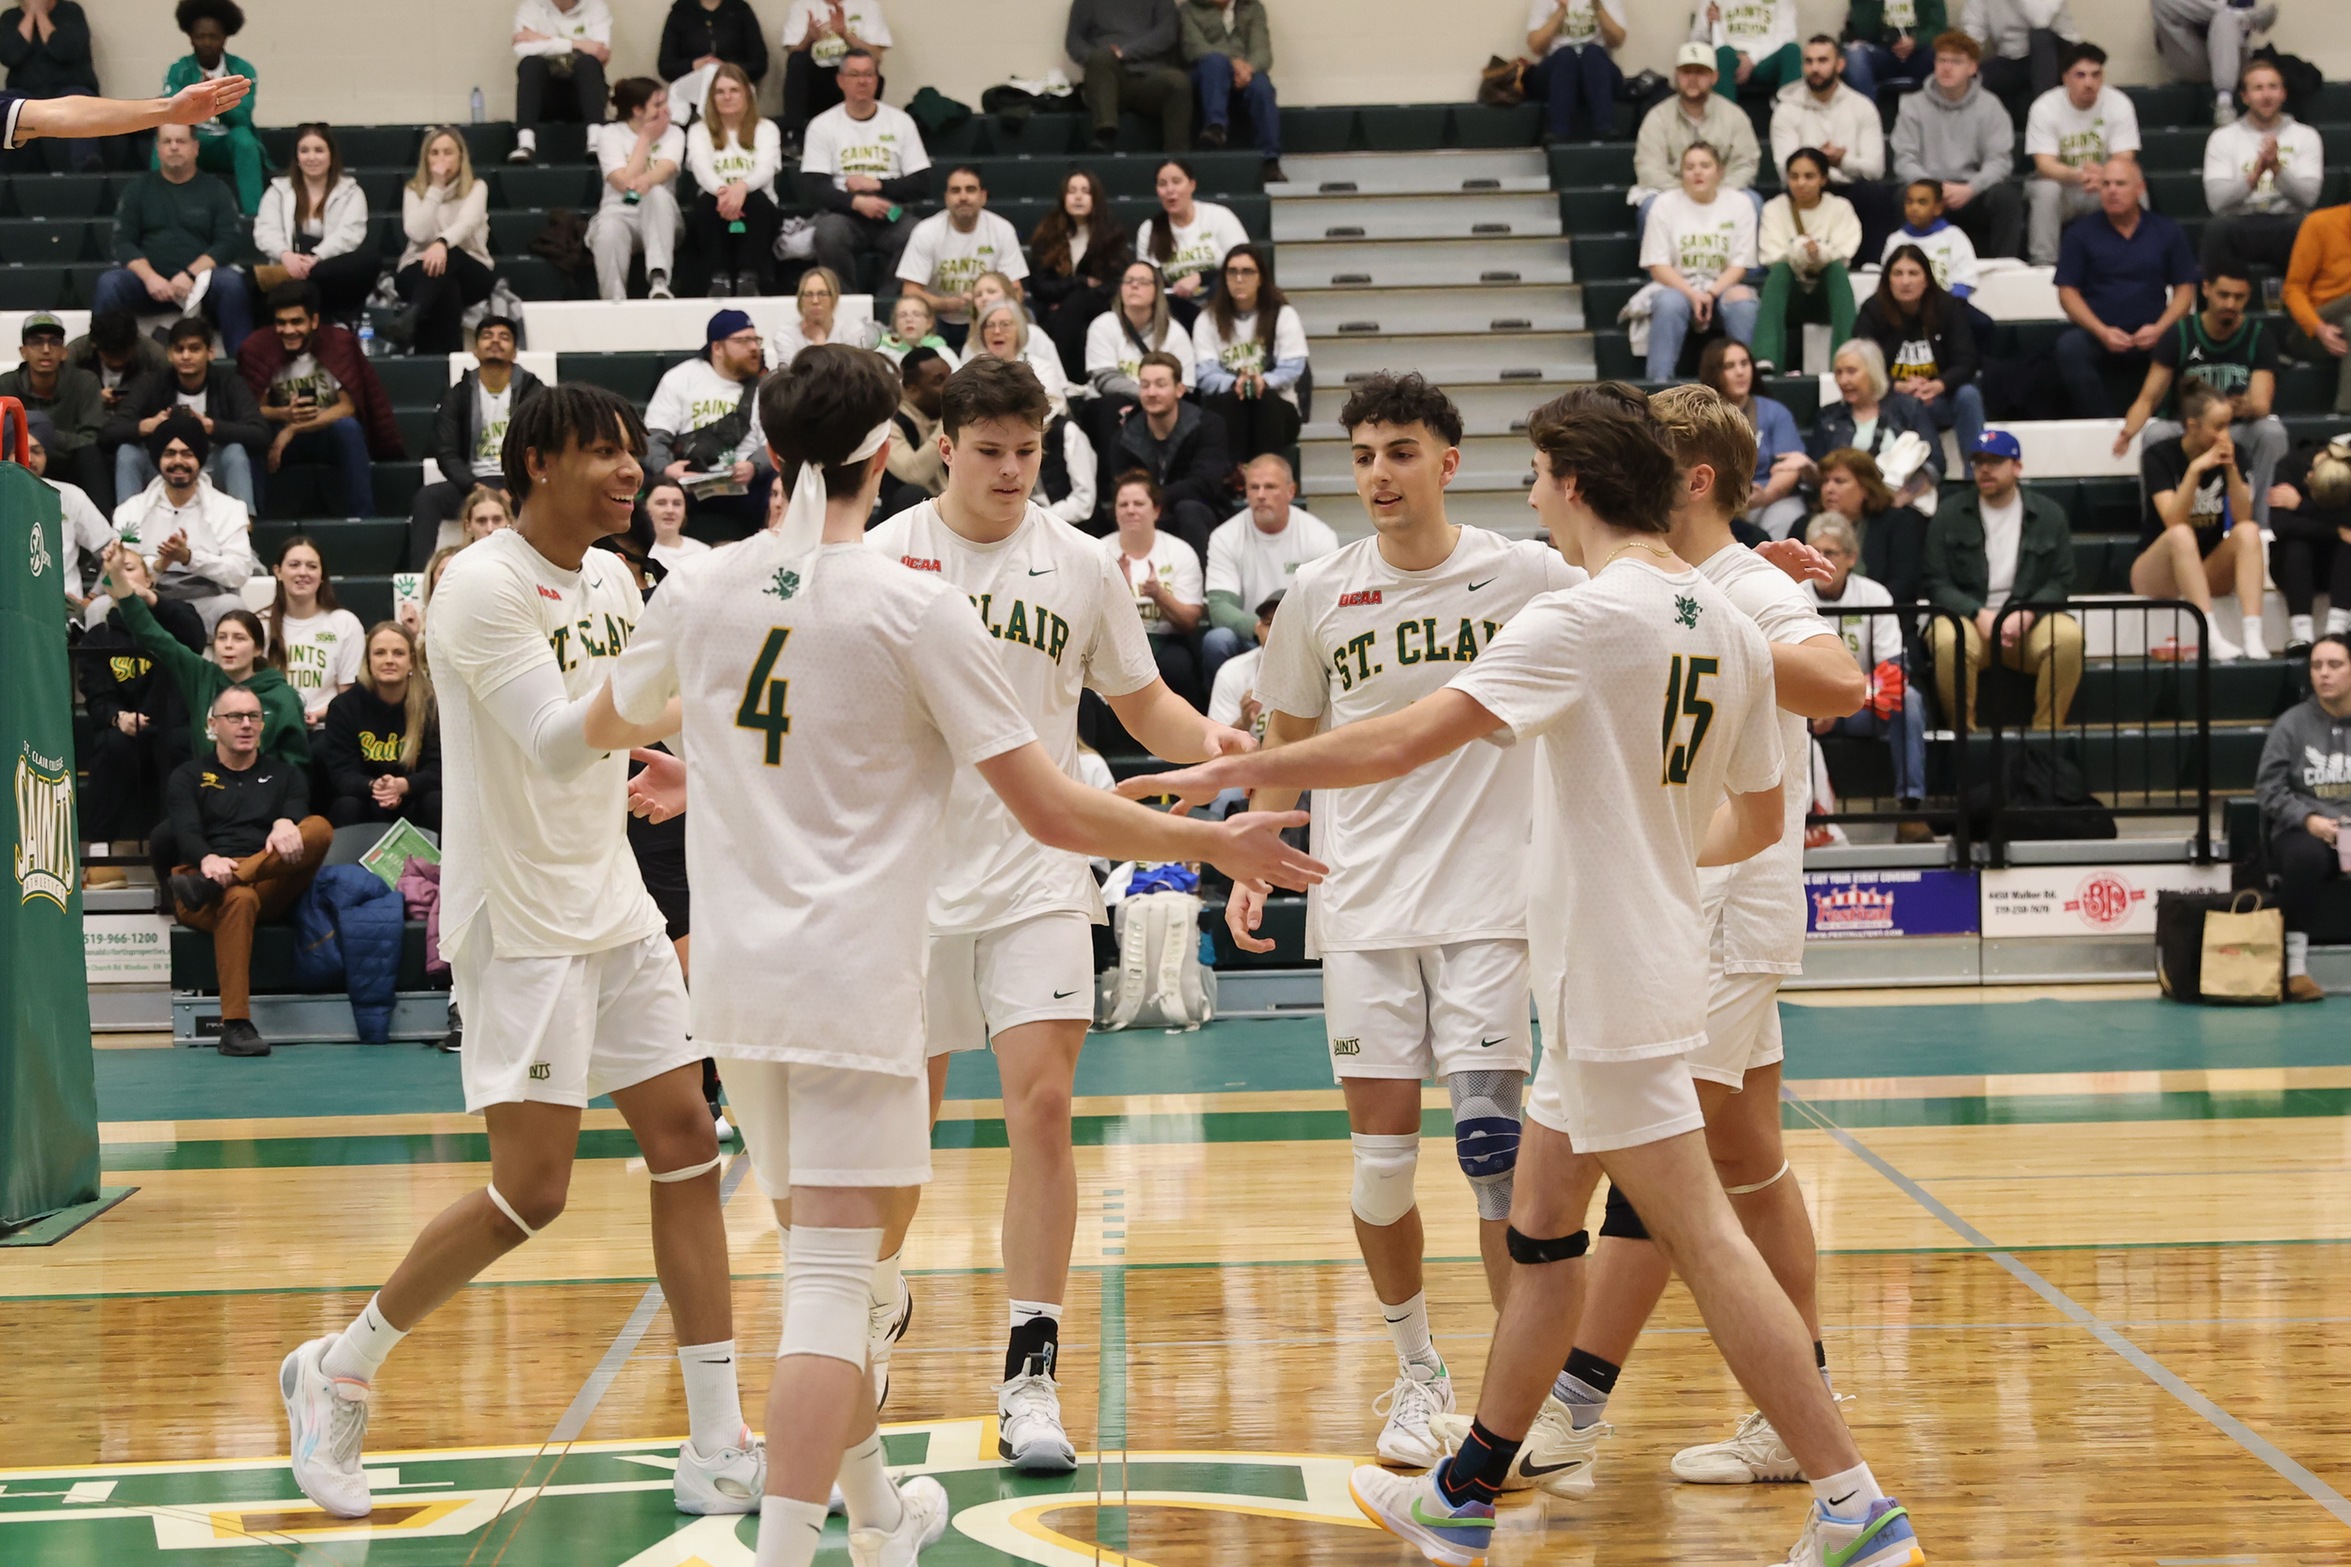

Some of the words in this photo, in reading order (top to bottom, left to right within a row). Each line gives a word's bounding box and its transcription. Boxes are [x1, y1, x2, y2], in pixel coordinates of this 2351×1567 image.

[841, 146, 891, 163] SAINTS
[1680, 234, 1730, 252] SAINTS
[692, 400, 738, 420] SAINT
[1337, 590, 1383, 607] OCAA
[968, 593, 1070, 666] LAIR
[287, 645, 327, 669] INTS
[549, 625, 578, 673] T.
[1333, 629, 1383, 691] ST.
[1396, 617, 1504, 666] CLA
[287, 669, 323, 689] TION
[735, 625, 792, 767] 4
[1661, 653, 1720, 787] 15
[14, 754, 75, 896] SAINTS
[24, 875, 66, 900] ATHLETICS
[84, 932, 159, 945] 519-966-1200
[529, 1062, 551, 1080] NTS
